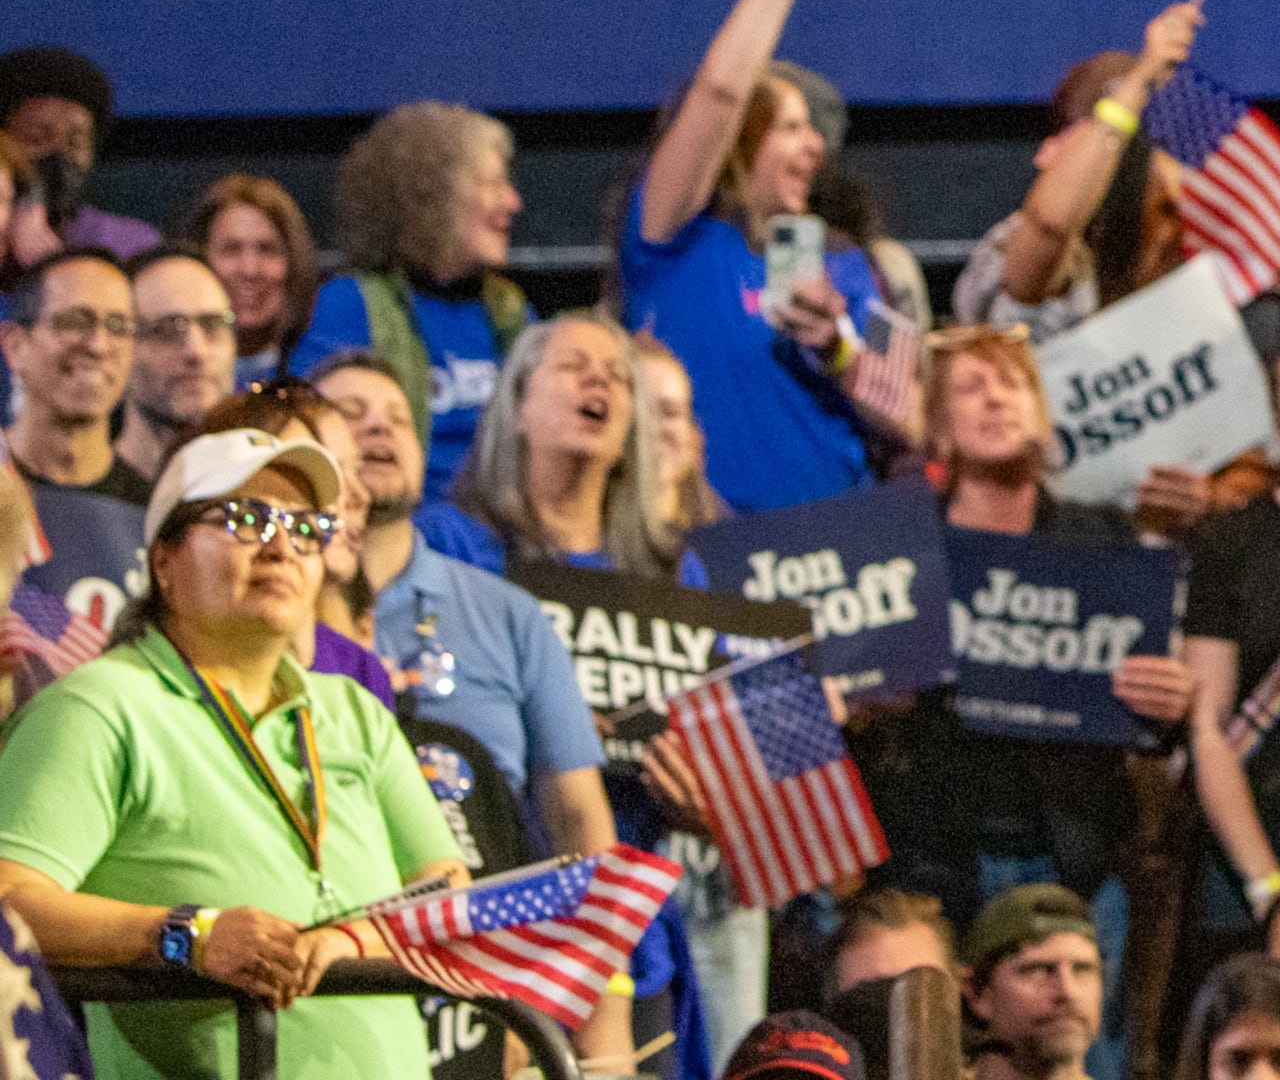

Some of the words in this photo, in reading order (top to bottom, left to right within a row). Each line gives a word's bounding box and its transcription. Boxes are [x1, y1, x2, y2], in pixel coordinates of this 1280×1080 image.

[1066, 356, 1150, 415] Jon
[743, 549, 847, 603] Jon
[972, 567, 1079, 624] Jon
